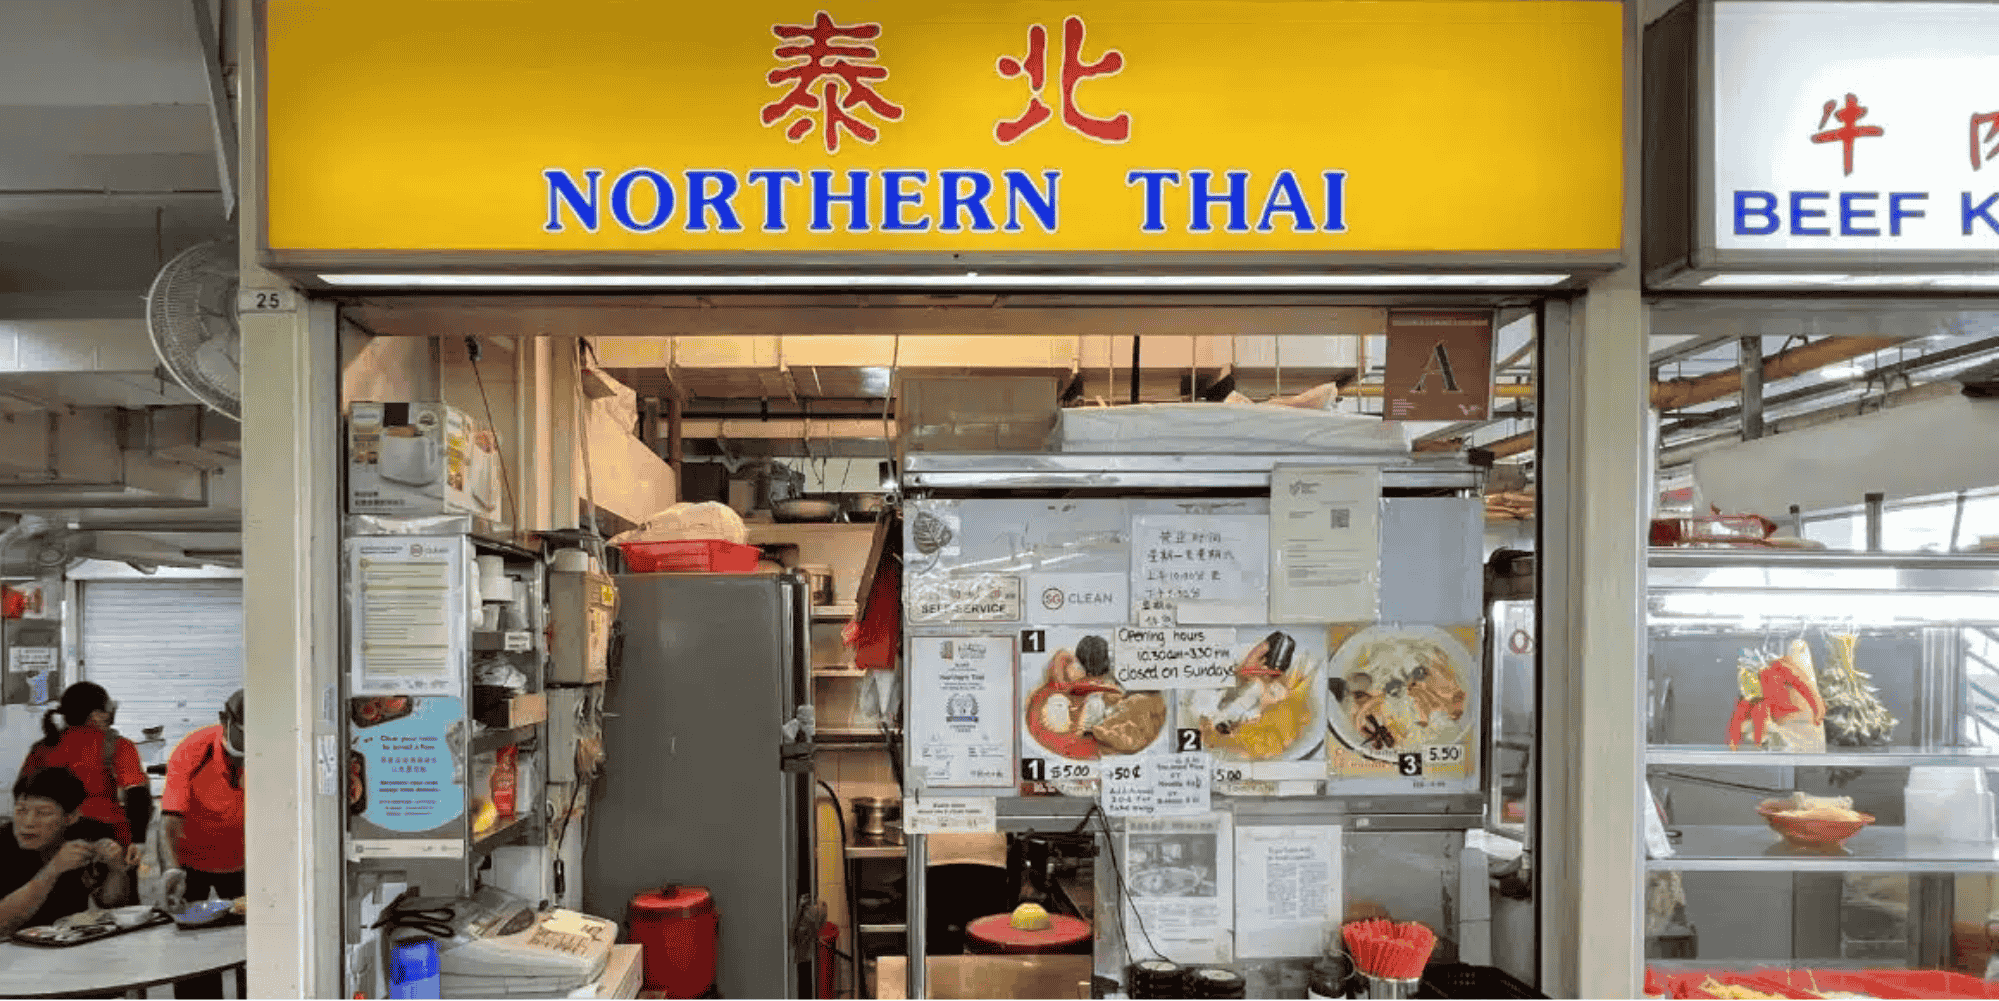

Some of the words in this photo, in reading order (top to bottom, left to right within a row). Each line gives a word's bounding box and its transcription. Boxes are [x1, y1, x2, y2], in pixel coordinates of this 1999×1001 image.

[760, 10, 1133, 154] 泰北
[543, 168, 1063, 234] NORTHERN
[1126, 168, 1349, 234] THAI
[1733, 189, 1929, 237] BEEF
[256, 292, 281, 309] 25
[1408, 340, 1464, 394] A
[1068, 593, 1113, 605] CLEAN
[1173, 630, 1205, 641] hours
[1161, 666, 1178, 678] on
[1183, 663, 1236, 683] Sundays
[1182, 730, 1197, 750] 2
[1403, 755, 1417, 774] 3
